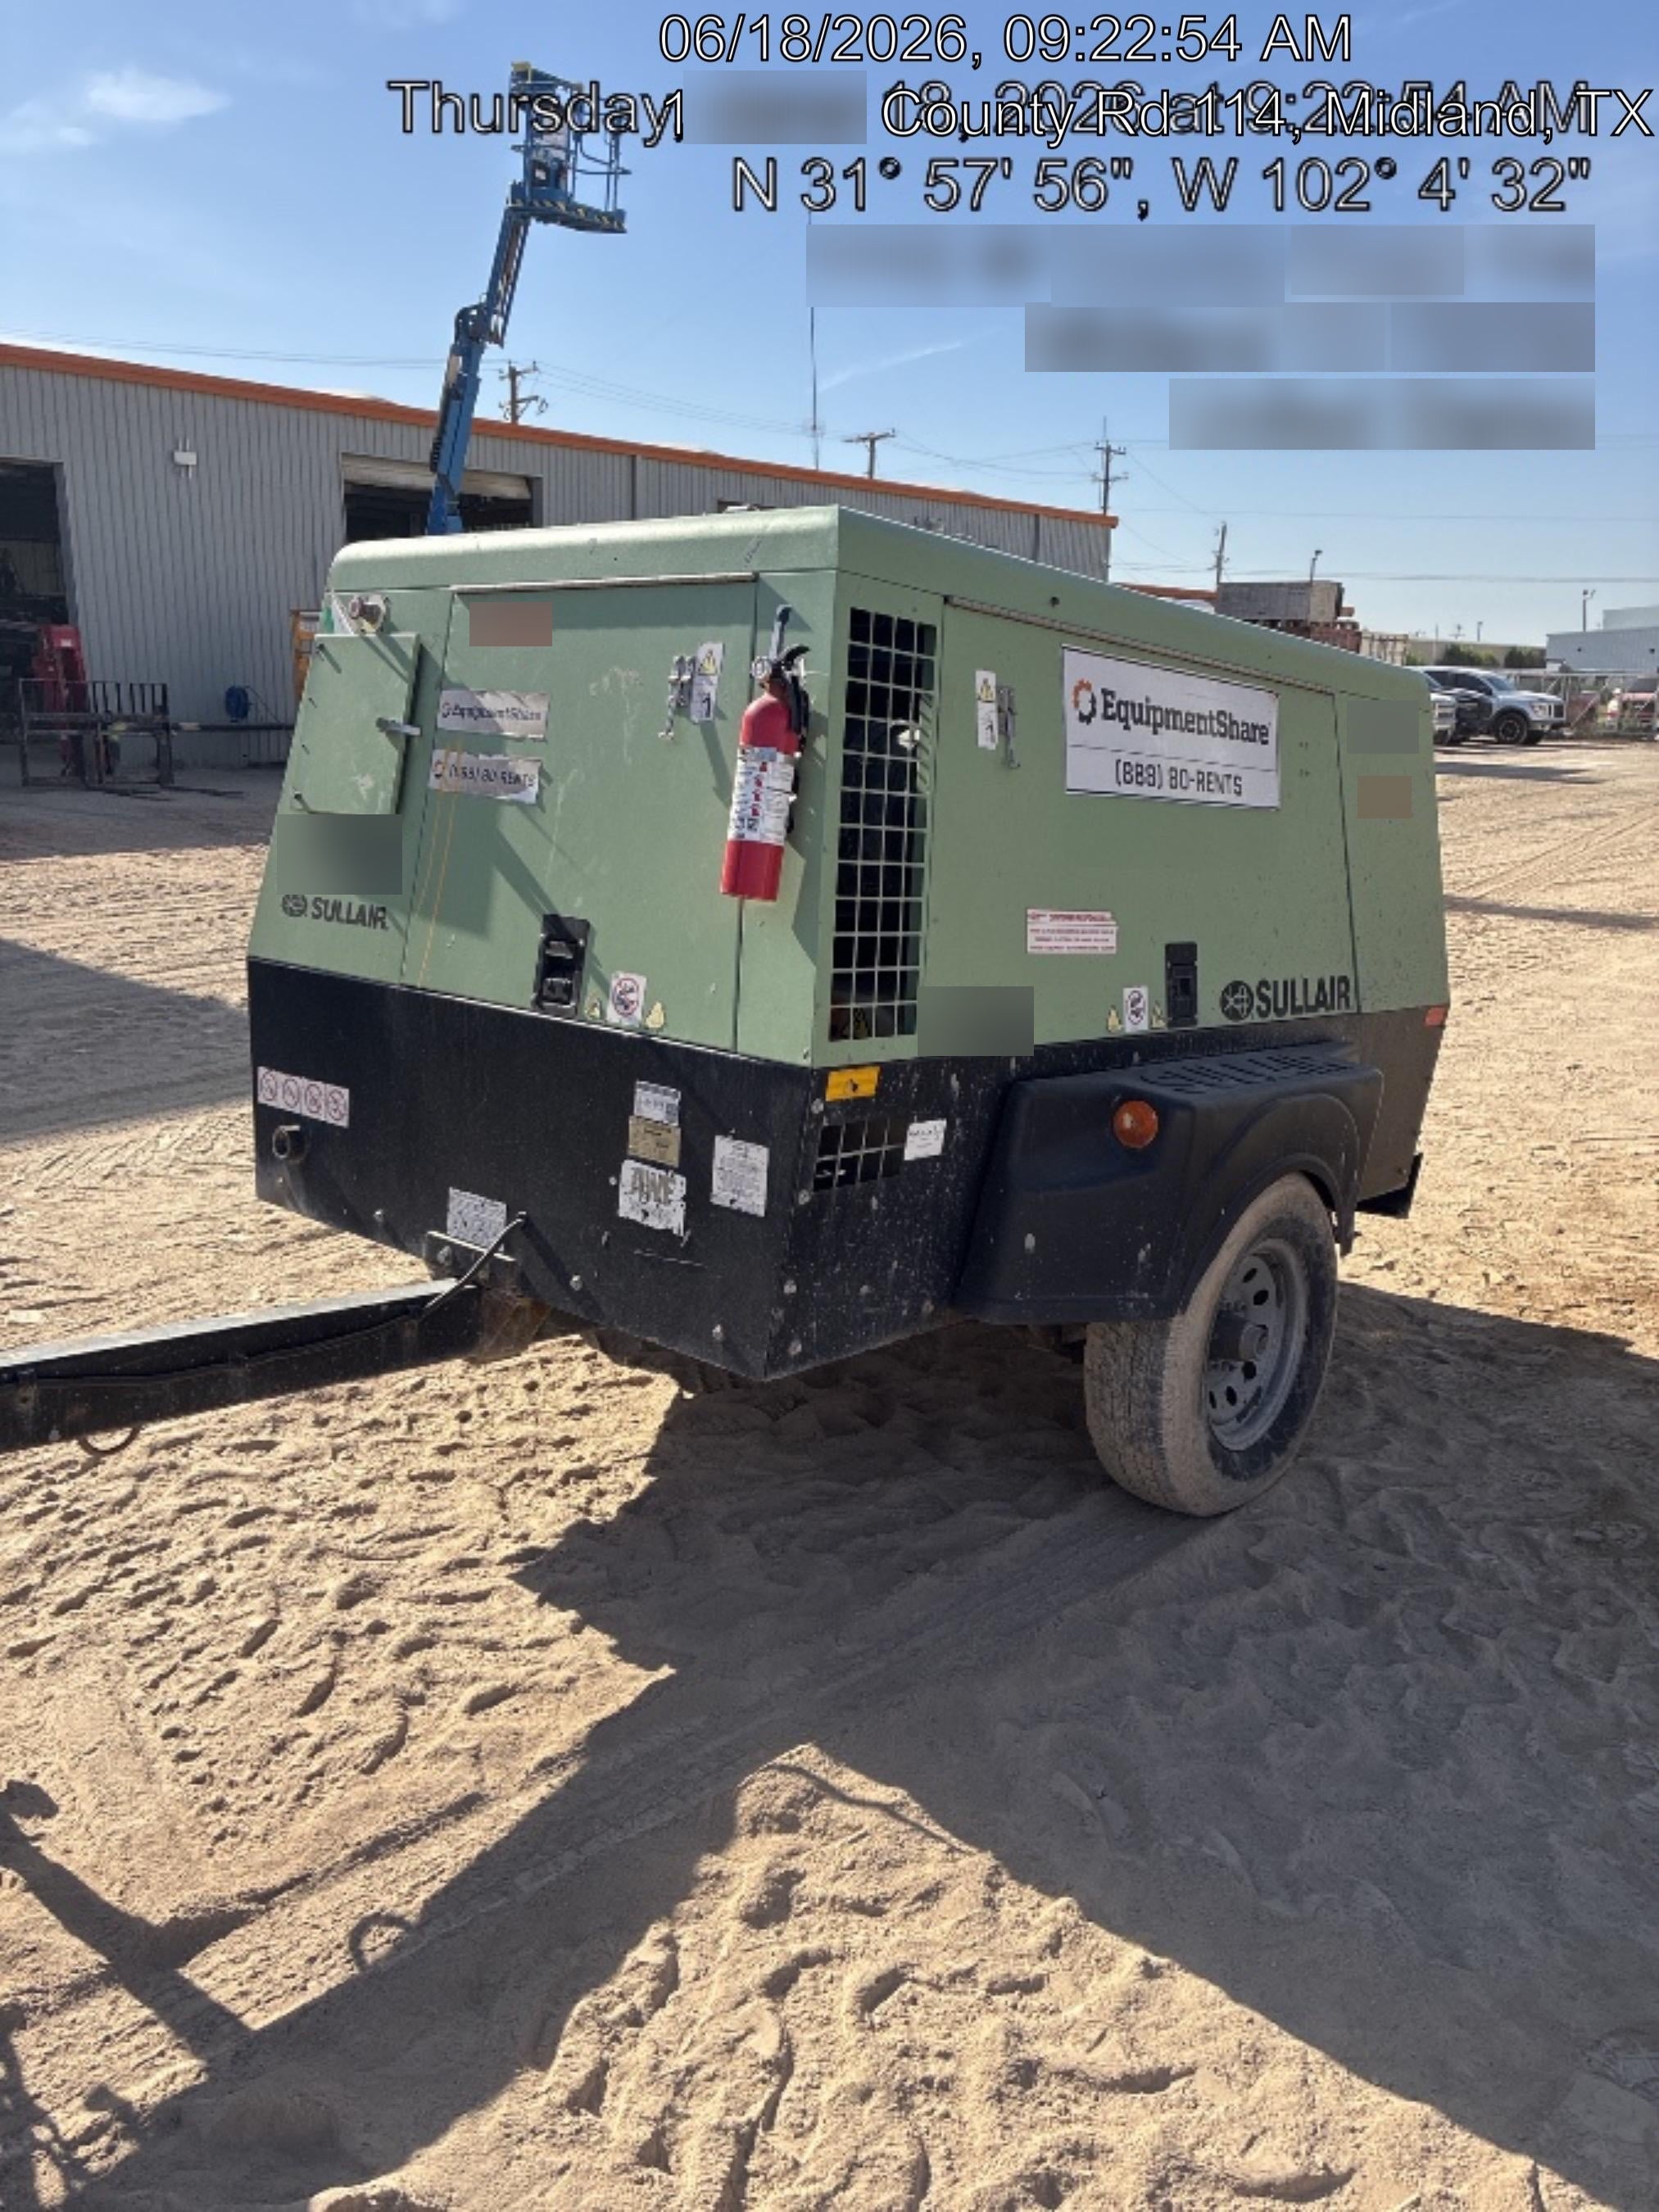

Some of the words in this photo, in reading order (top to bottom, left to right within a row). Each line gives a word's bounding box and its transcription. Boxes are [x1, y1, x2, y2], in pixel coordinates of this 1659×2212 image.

[1100, 687, 1269, 746] EquipmentShare
[1115, 759, 1164, 791] (888)
[1168, 766, 1243, 797] 80-RENTS
[311, 896, 389, 931] SULLAIR
[1255, 974, 1352, 1019] SULLAIR
